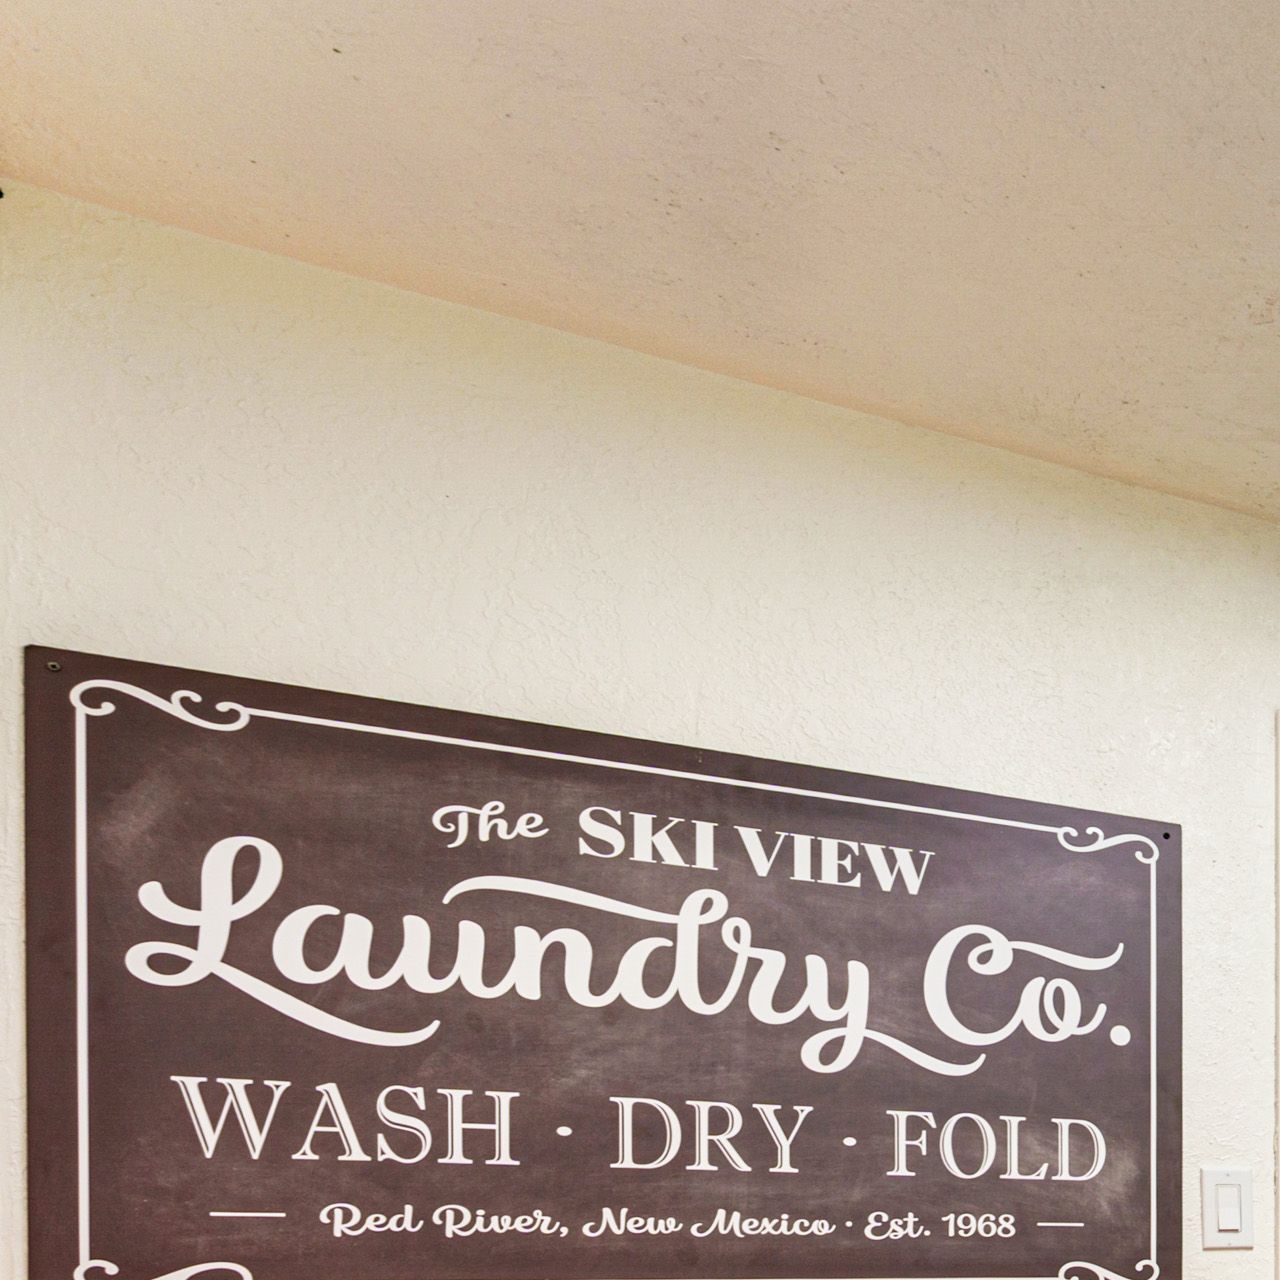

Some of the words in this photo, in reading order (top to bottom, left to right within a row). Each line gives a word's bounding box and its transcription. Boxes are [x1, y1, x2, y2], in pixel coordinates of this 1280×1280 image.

[432, 801, 550, 848] The
[578, 806, 719, 872] SKI
[734, 825, 936, 896] VIEW
[124, 835, 986, 1077] Laundry
[923, 923, 1133, 1047] Co.
[170, 1075, 521, 1167] WASH
[609, 1096, 814, 1174] DRY
[886, 1108, 1108, 1182] FOLD
[318, 1203, 424, 1239] Red
[432, 1202, 569, 1239] River,
[582, 1206, 684, 1239] New
[690, 1207, 837, 1239] Mexico
[863, 1209, 932, 1239] Est.
[941, 1212, 1017, 1239] 1968
